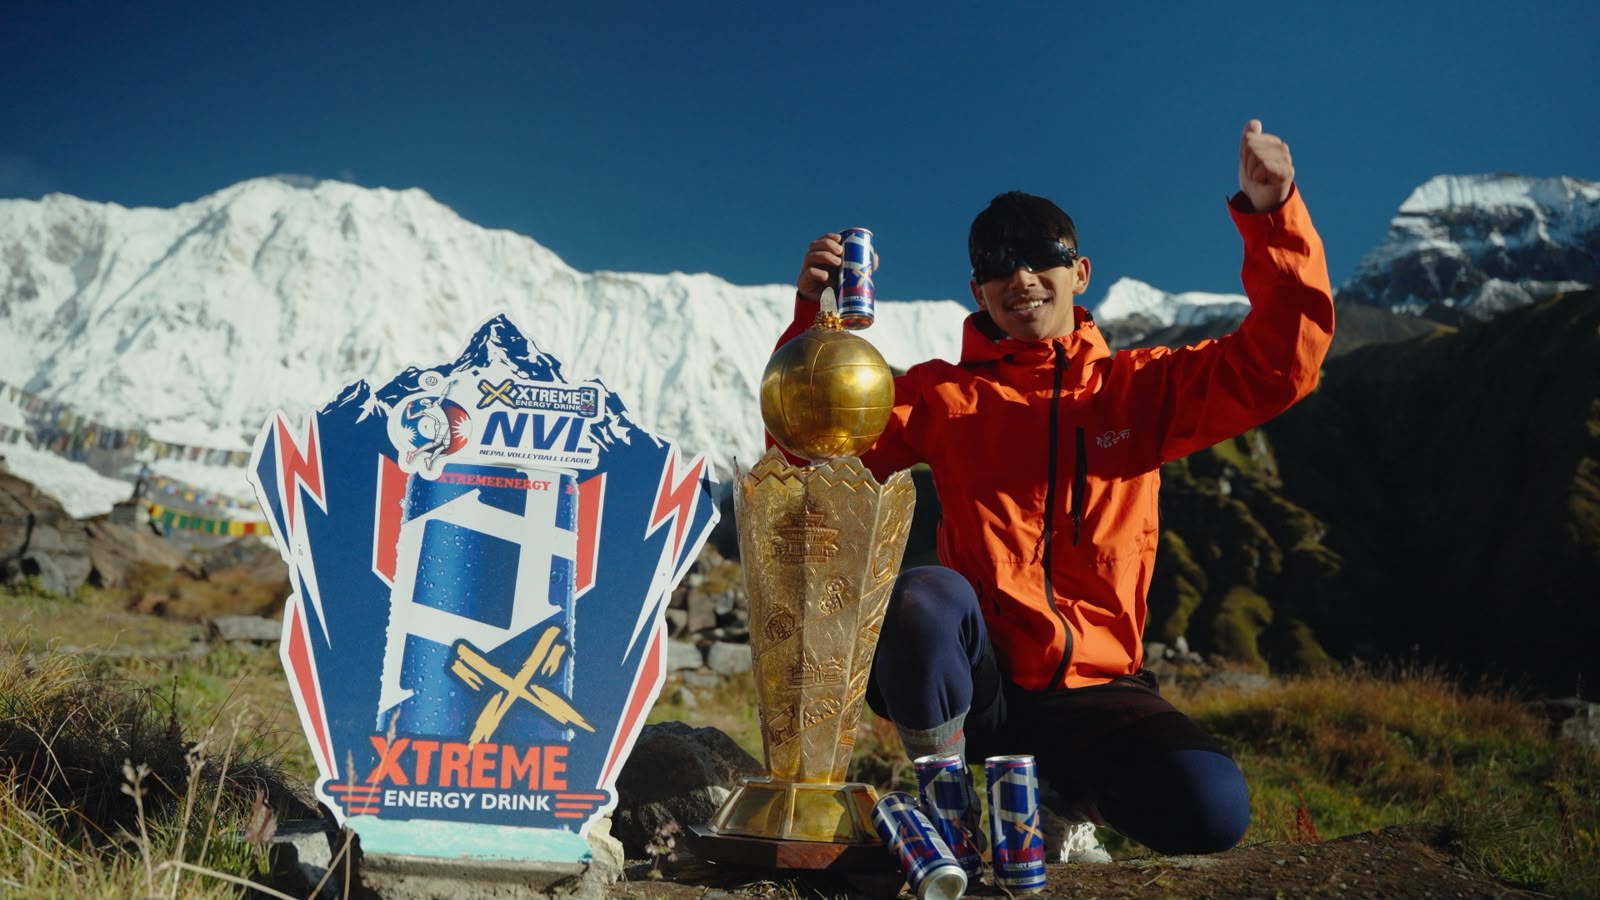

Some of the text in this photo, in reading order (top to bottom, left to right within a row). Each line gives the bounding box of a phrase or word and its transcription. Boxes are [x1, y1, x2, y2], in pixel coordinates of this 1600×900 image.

[515, 399, 551, 409] ENERGY
[517, 386, 581, 405] XTREME
[480, 411, 593, 454] NVL
[479, 449, 592, 465] NEPAL VOLLEYBALL LEAGUE
[365, 736, 569, 791] XTREME
[383, 789, 551, 812] ENERGY DRINK
